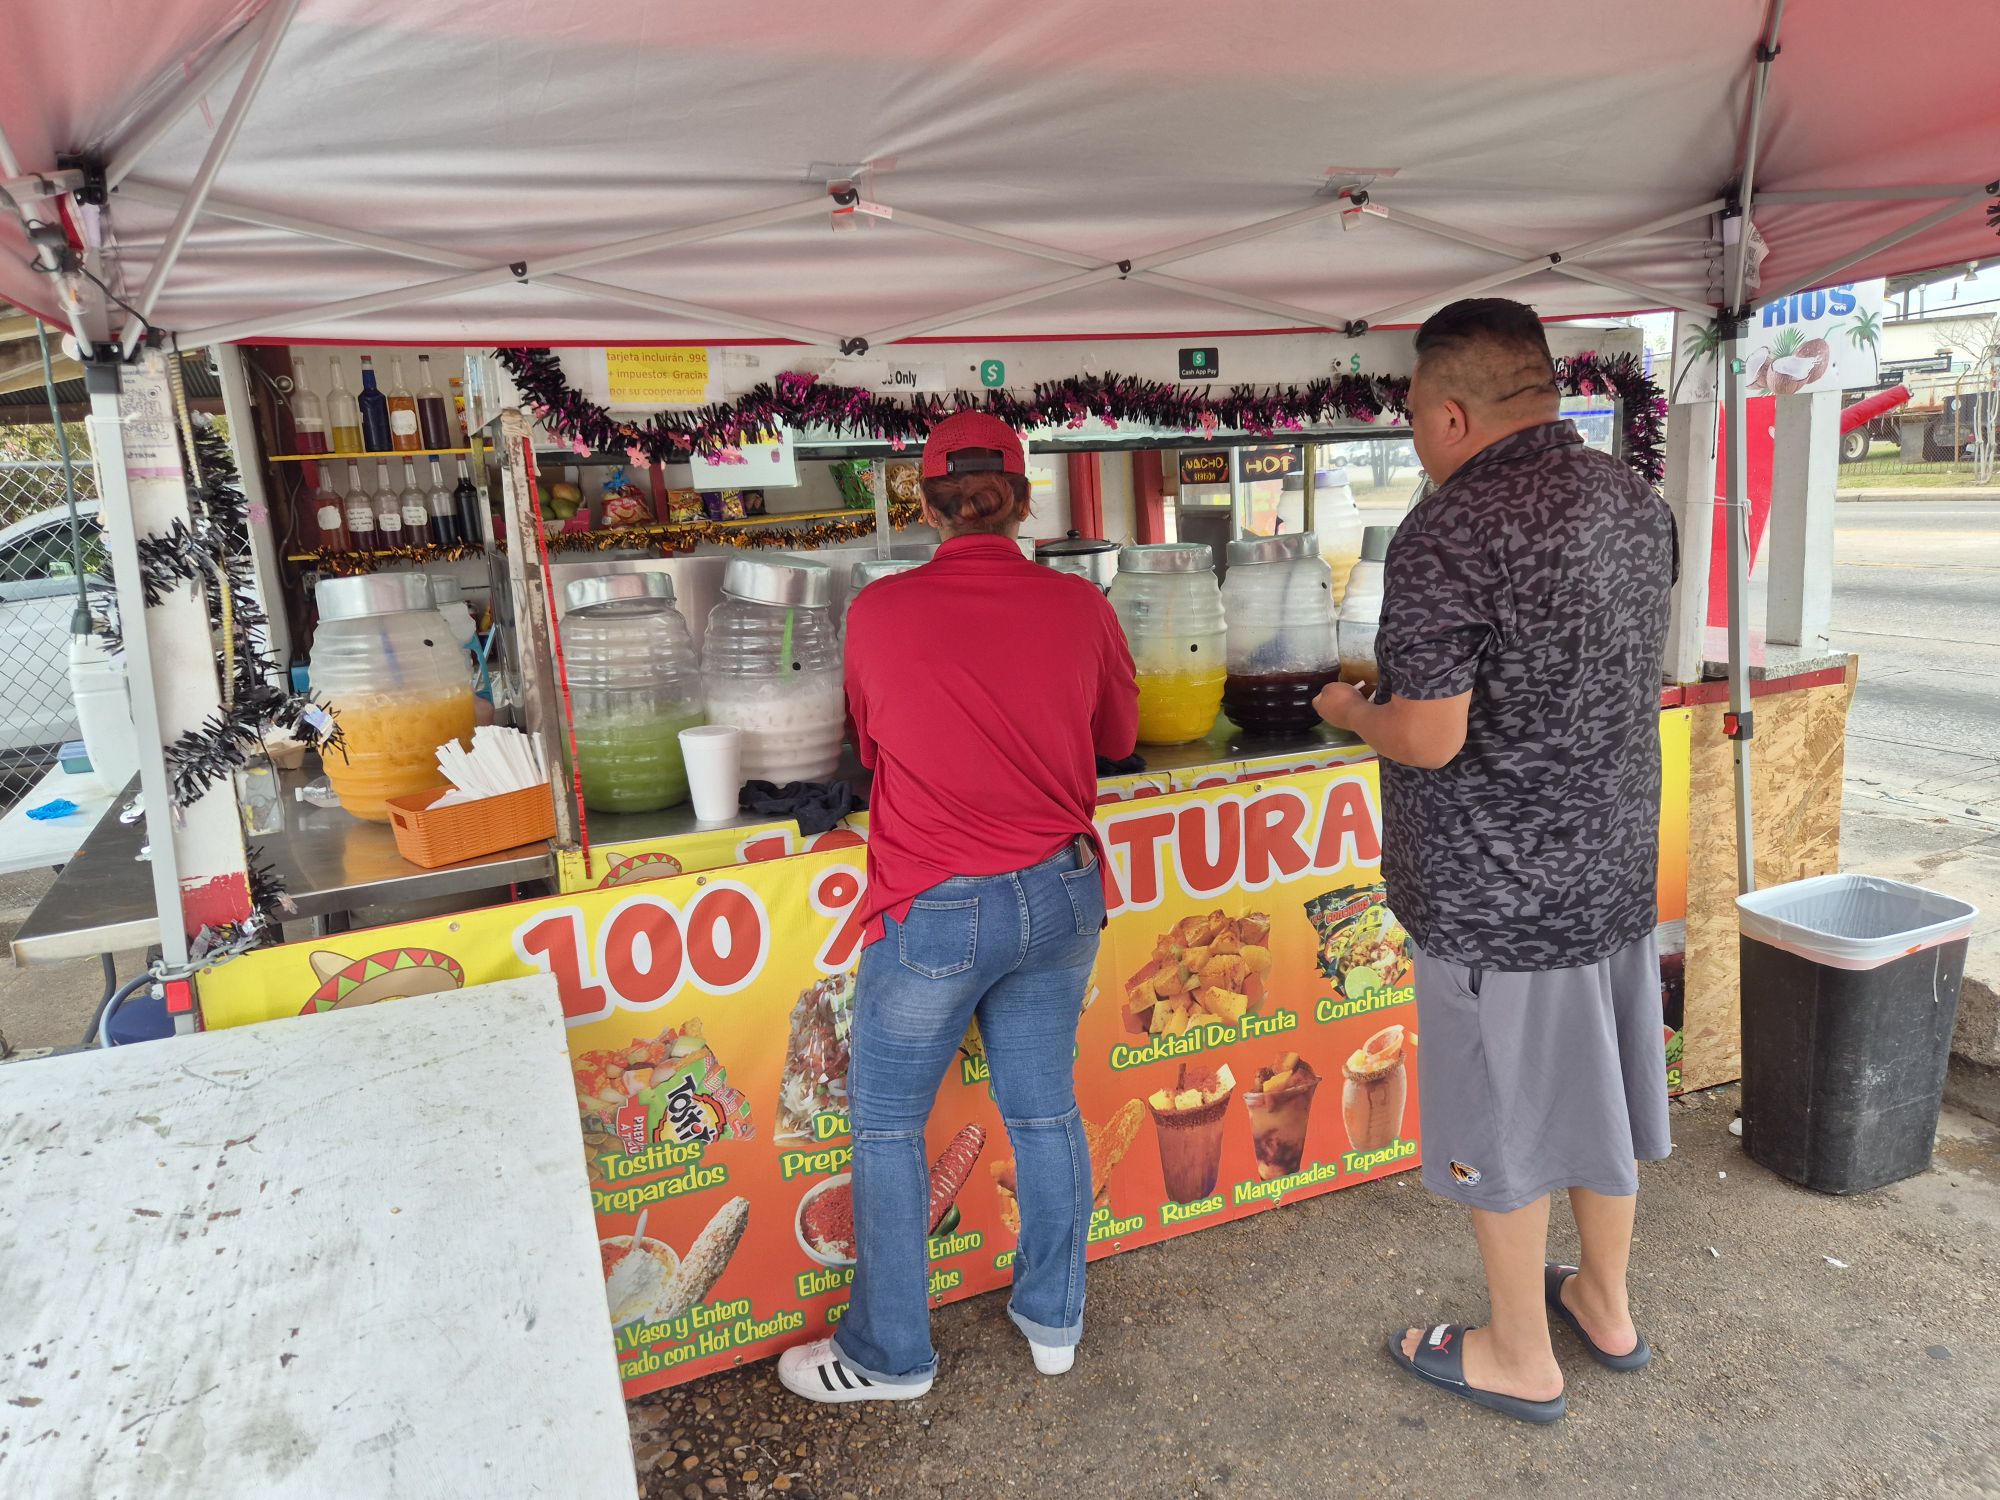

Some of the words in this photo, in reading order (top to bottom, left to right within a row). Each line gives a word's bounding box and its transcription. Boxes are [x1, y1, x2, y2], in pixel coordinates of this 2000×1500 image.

[606, 352, 640, 364] tarjeta
[642, 351, 684, 363] incluirán
[1207, 368, 1218, 376] Pay
[672, 369, 708, 381] Gracias
[895, 370, 917, 388] Only
[1185, 456, 1224, 470] NACHO
[1245, 453, 1296, 474] HOT
[521, 887, 763, 1019] 100
[1316, 986, 1416, 1022] Conchitas
[1111, 1028, 1201, 1069] Cocktail
[1206, 1024, 1237, 1048] De
[1241, 1010, 1297, 1039] Fruta
[600, 1142, 702, 1180] Tostitos
[1343, 1138, 1416, 1172] Tepache
[1234, 1163, 1336, 1204] Mangonadas
[1162, 1194, 1223, 1224] Rusas
[1086, 1214, 1144, 1242] Entero
[797, 1269, 842, 1298] Elote
[928, 1232, 982, 1260] Entero
[624, 1320, 671, 1348] Vaso
[675, 1315, 689, 1340] y
[691, 1299, 750, 1330] Entero
[663, 1343, 696, 1367] con
[699, 1330, 731, 1356] Hot
[733, 1311, 805, 1345] Cheetos
